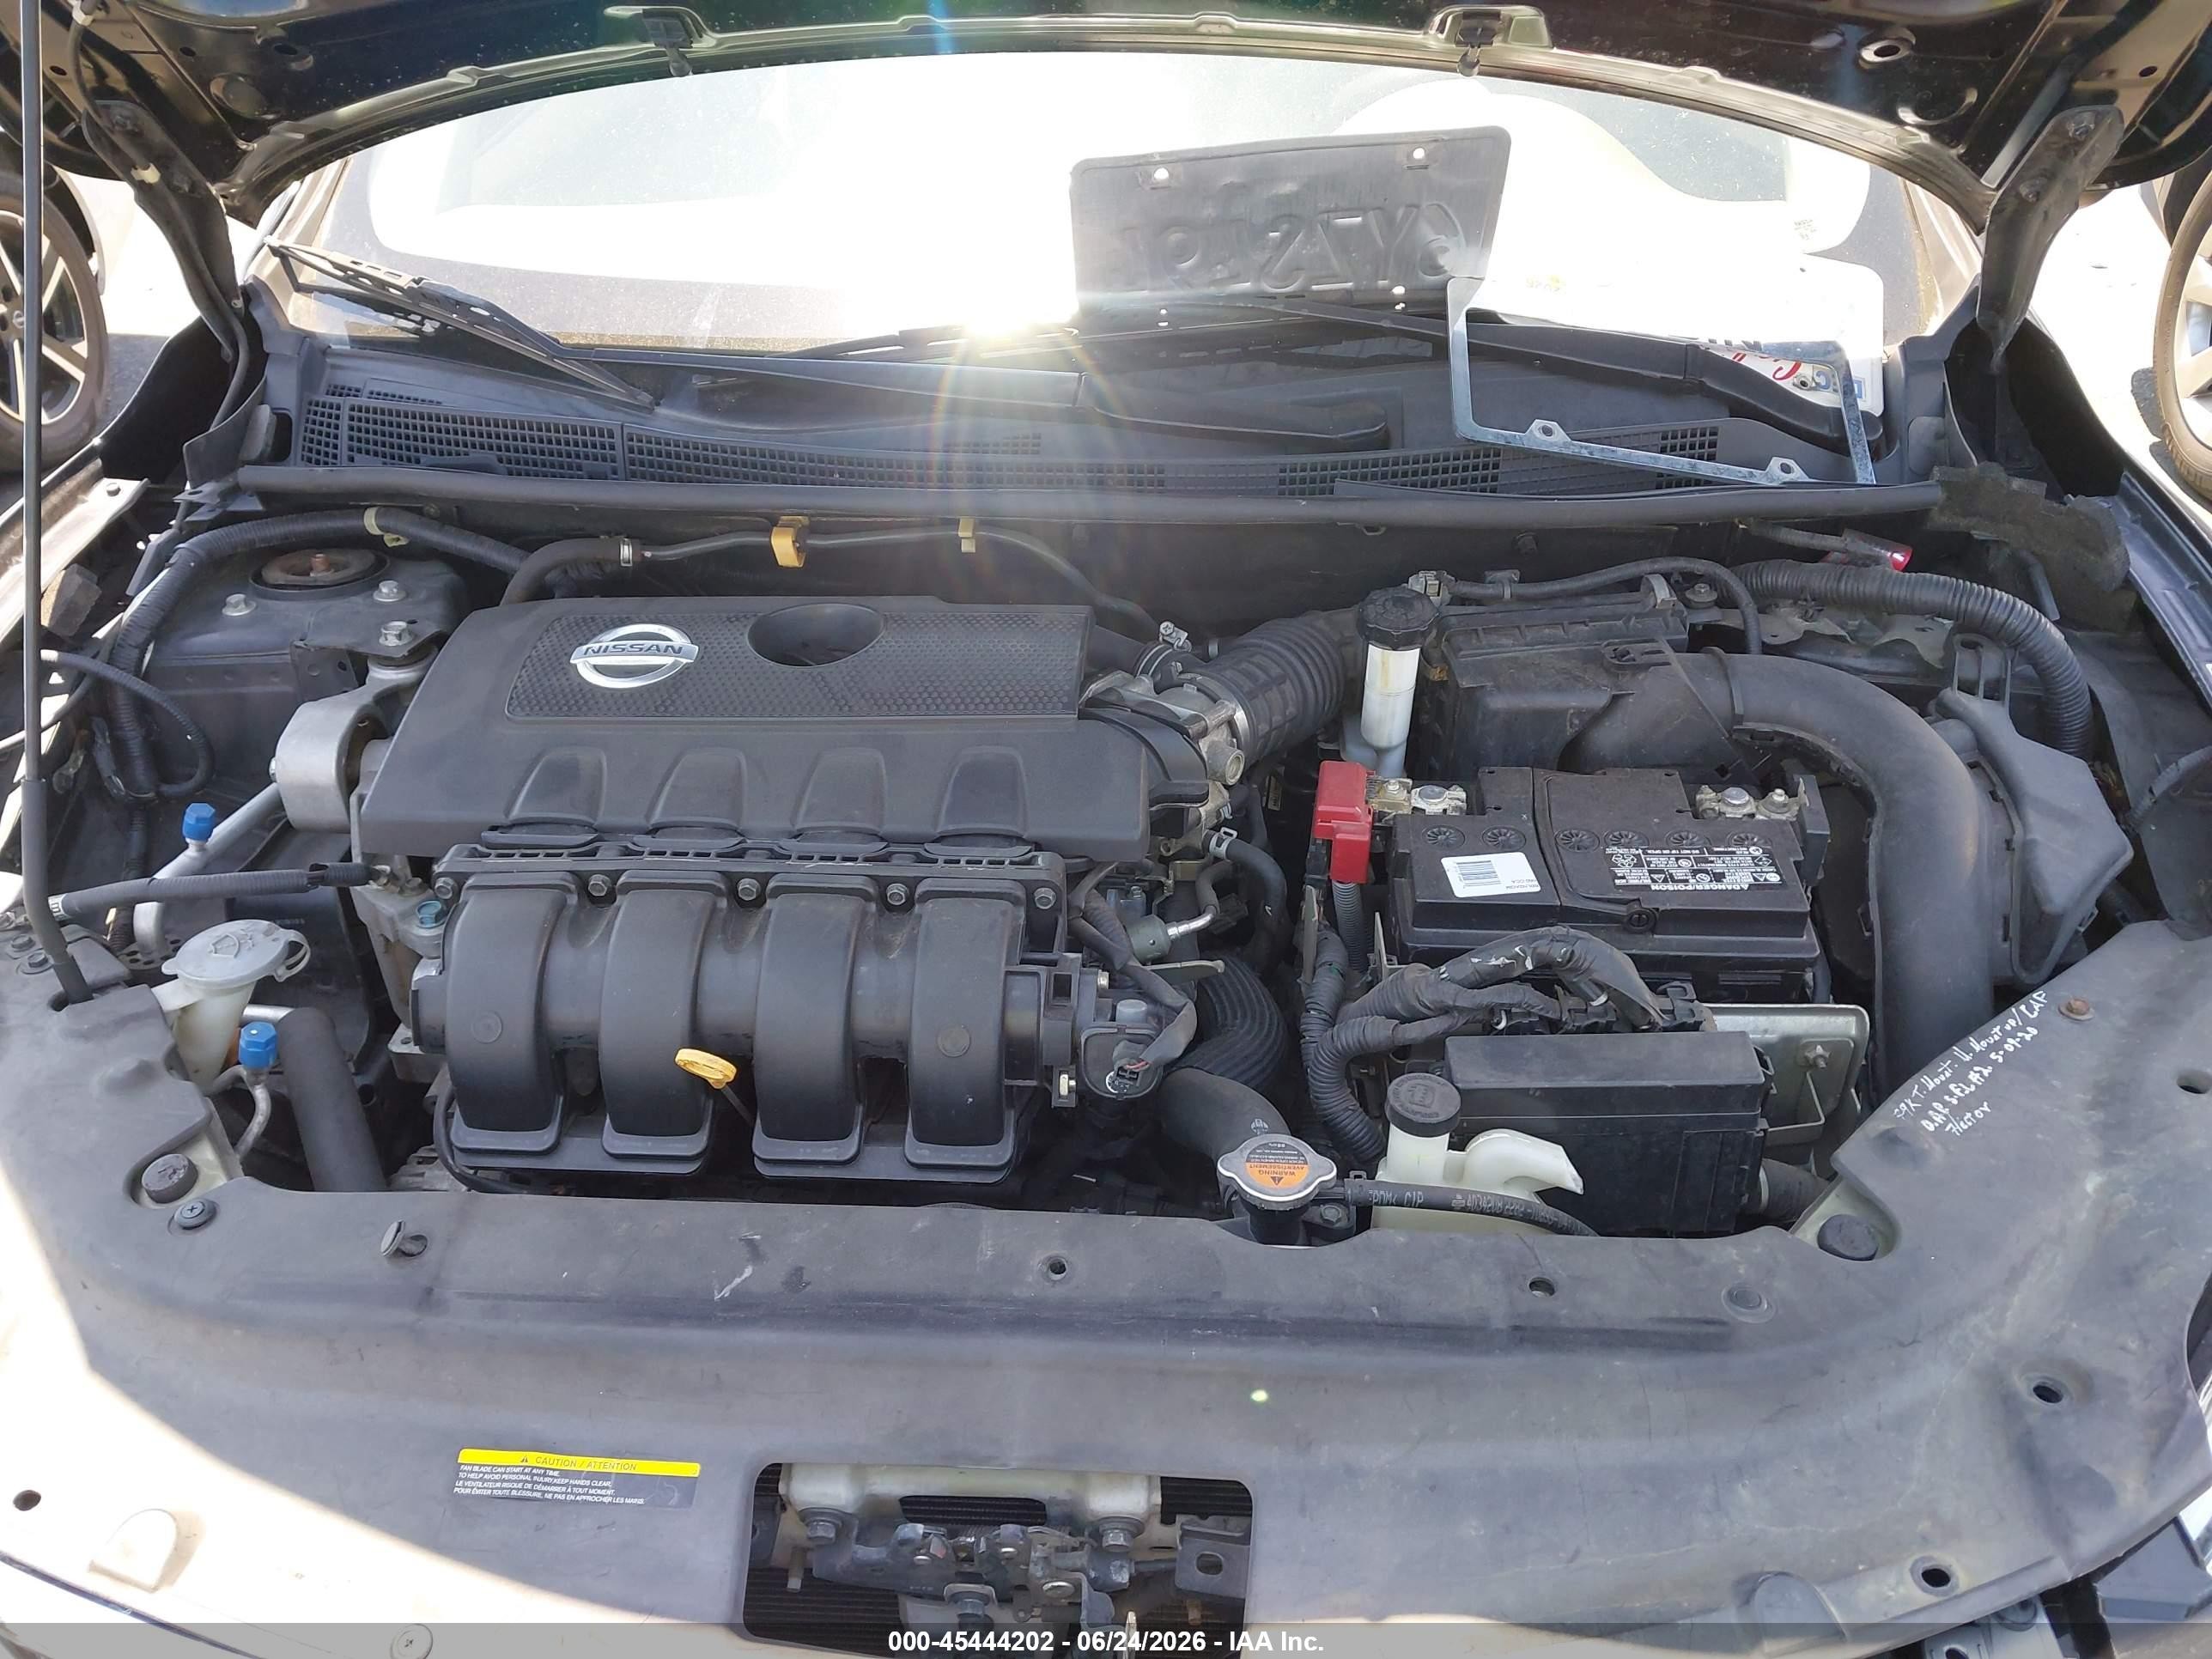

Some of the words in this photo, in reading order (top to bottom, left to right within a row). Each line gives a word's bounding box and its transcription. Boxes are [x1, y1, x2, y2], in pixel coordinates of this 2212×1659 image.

[583, 642, 684, 655] NISSAN
[536, 1456, 577, 1468] CAUTION
[586, 1462, 637, 1471] ATTENTION
